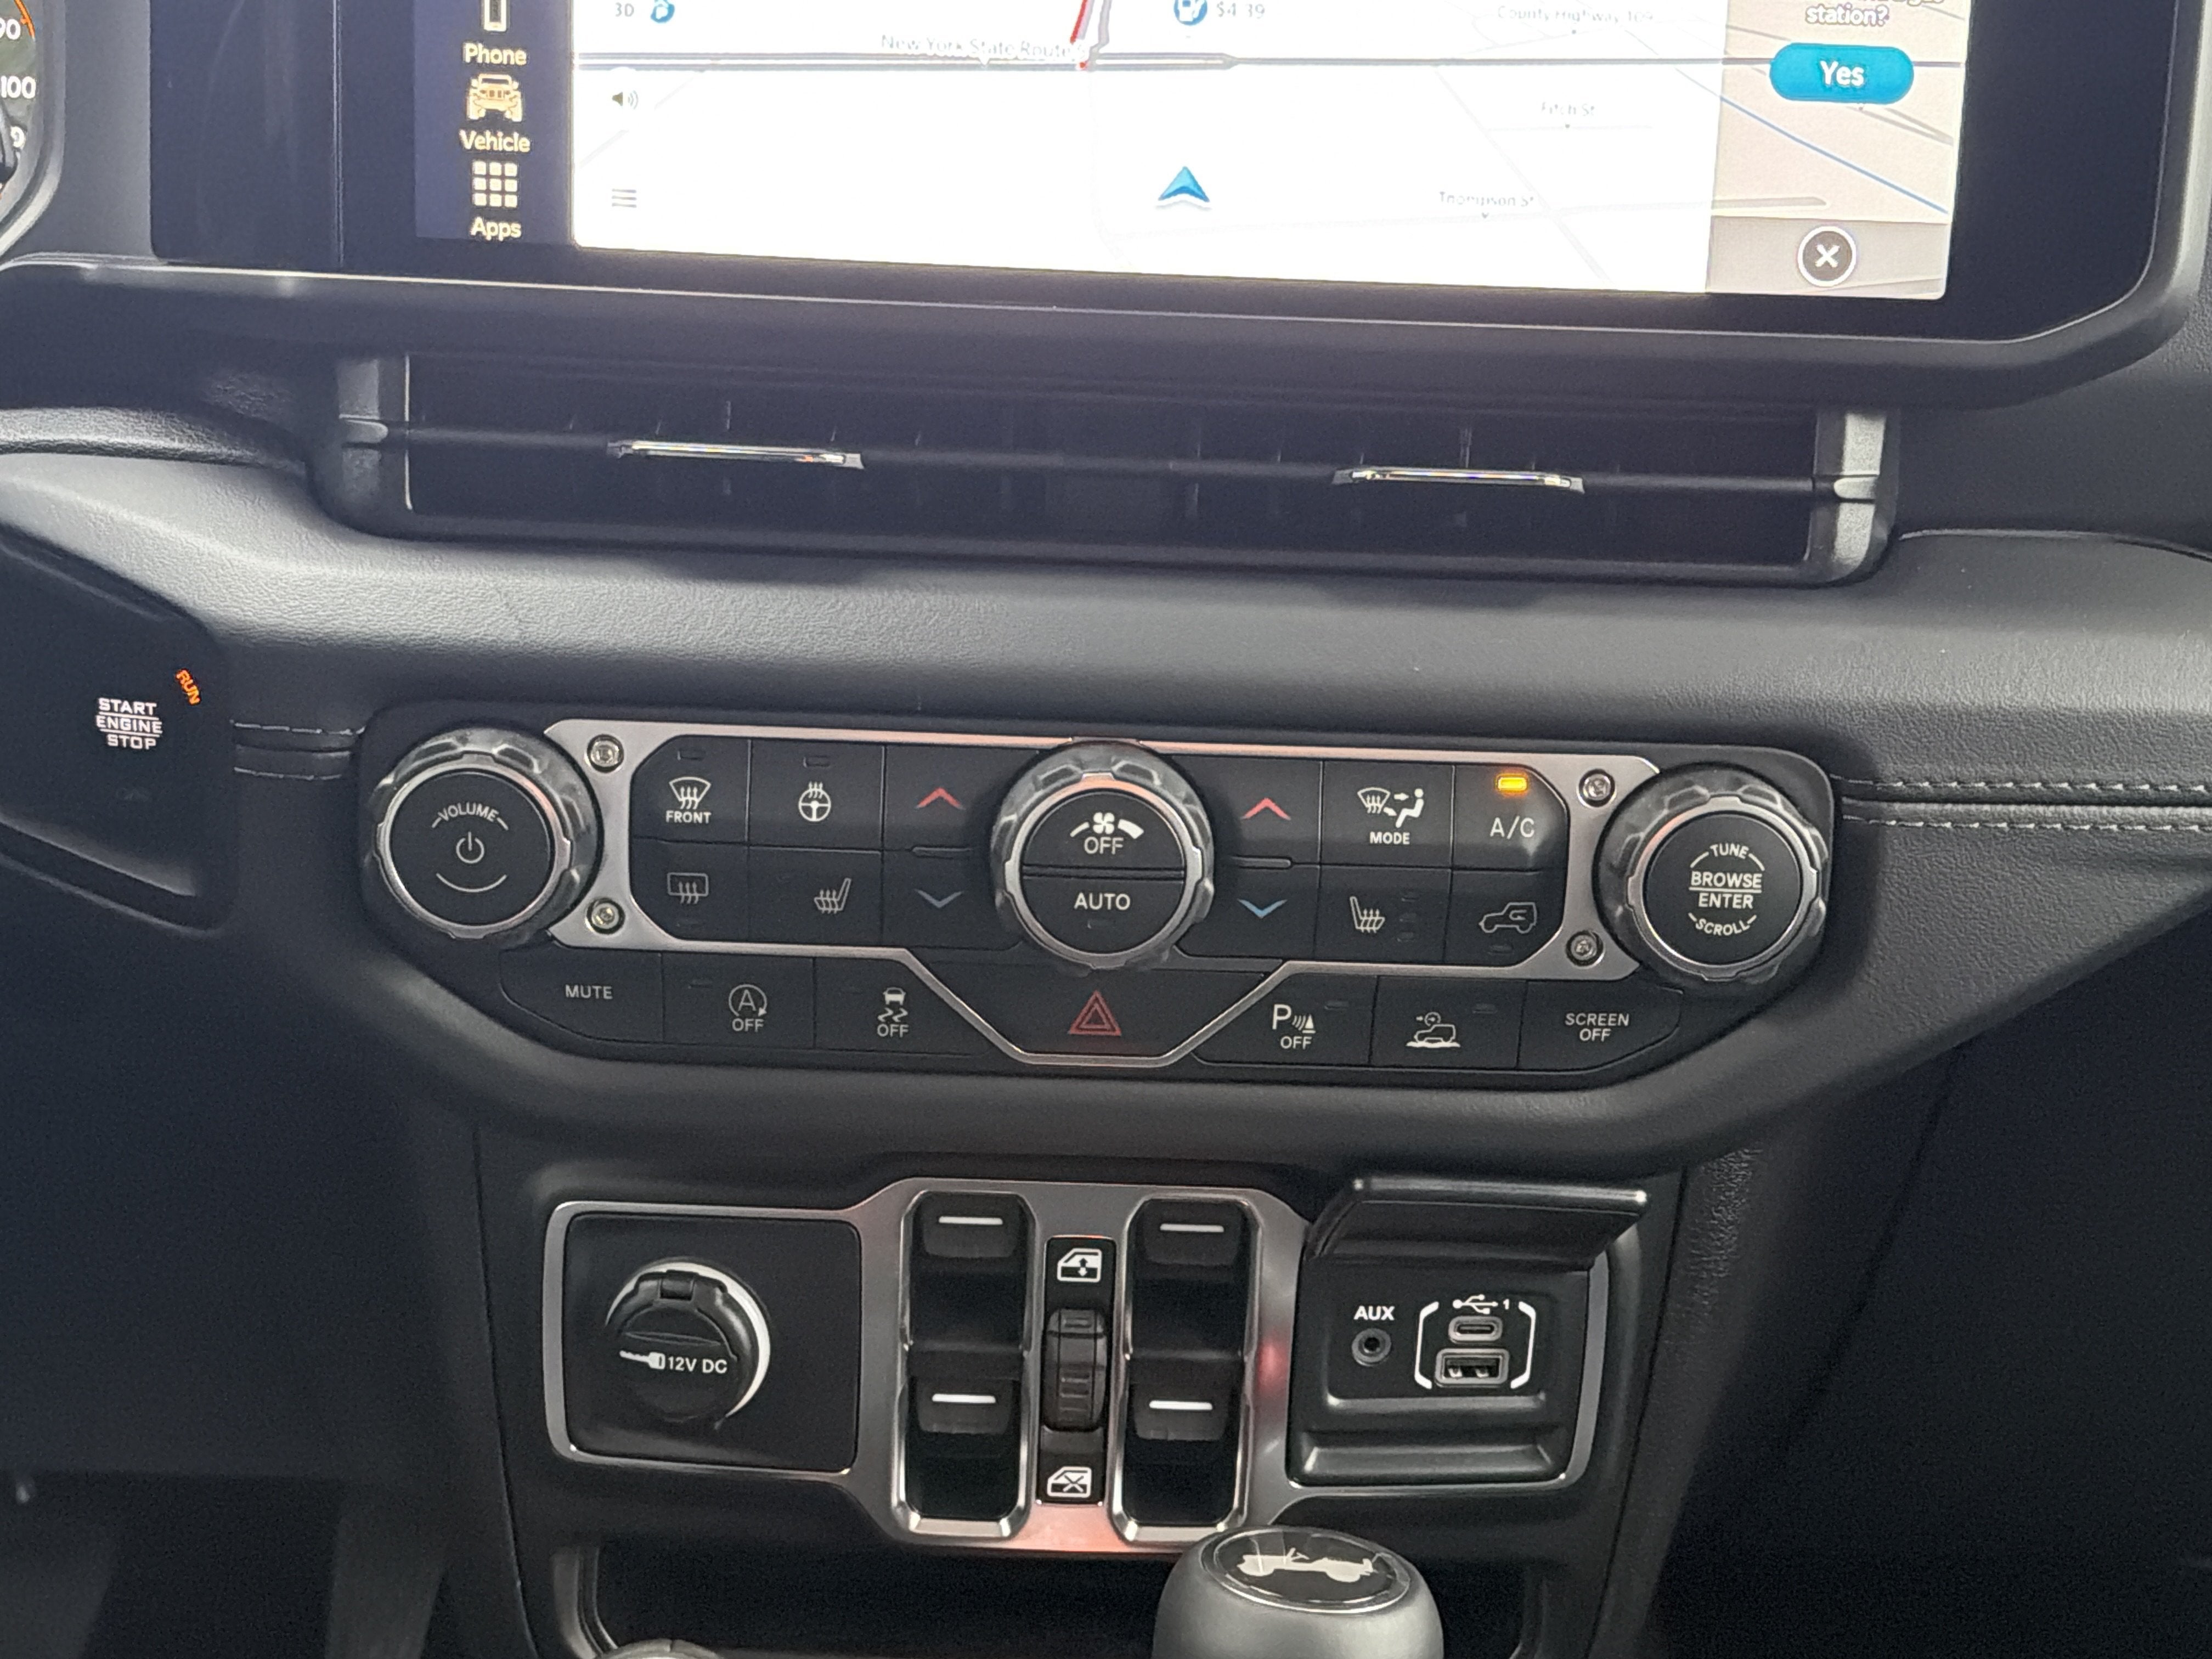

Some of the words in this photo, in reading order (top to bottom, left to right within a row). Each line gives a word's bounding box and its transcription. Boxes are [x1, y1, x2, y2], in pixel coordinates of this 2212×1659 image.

[615, 2, 634, 17] 3D
[1498, 5, 1549, 22] County
[1806, 3, 1889, 26] station?
[464, 42, 527, 65] Phone
[881, 34, 921, 50] New
[926, 36, 963, 53] York
[969, 38, 1015, 54] State
[1020, 41, 1070, 57] Route
[1820, 60, 1865, 86] Yes
[1, 76, 36, 99] 100
[460, 129, 531, 153] Vehicle
[470, 216, 522, 241] Apps
[176, 669, 201, 706] RUN
[98, 697, 157, 715] START
[96, 715, 163, 734] ENGINE
[107, 733, 156, 750] STOP
[438, 802, 499, 822] VOLUME
[665, 810, 712, 824] FRONT
[1489, 817, 1535, 839] A/C
[1084, 837, 1124, 855] OFF
[1369, 831, 1410, 845] MODE
[1709, 843, 1750, 860] TUNE
[1690, 871, 1763, 889] BROWSE
[1074, 892, 1131, 910] AUTO
[1699, 893, 1754, 909] ENTER
[1695, 918, 1750, 936] SCROLL
[565, 985, 613, 1000] MUTE
[732, 1018, 764, 1032] OFF
[1272, 1003, 1291, 1030] P
[1565, 1012, 1629, 1027] SCREEN
[877, 1023, 909, 1037] OFF
[1579, 1028, 1612, 1042] OFF
[1280, 1035, 1312, 1050] OFF
[1353, 1306, 1396, 1321] AUX
[1503, 1299, 1510, 1310] 1
[668, 1357, 697, 1372] 12V
[702, 1358, 727, 1374] DC
